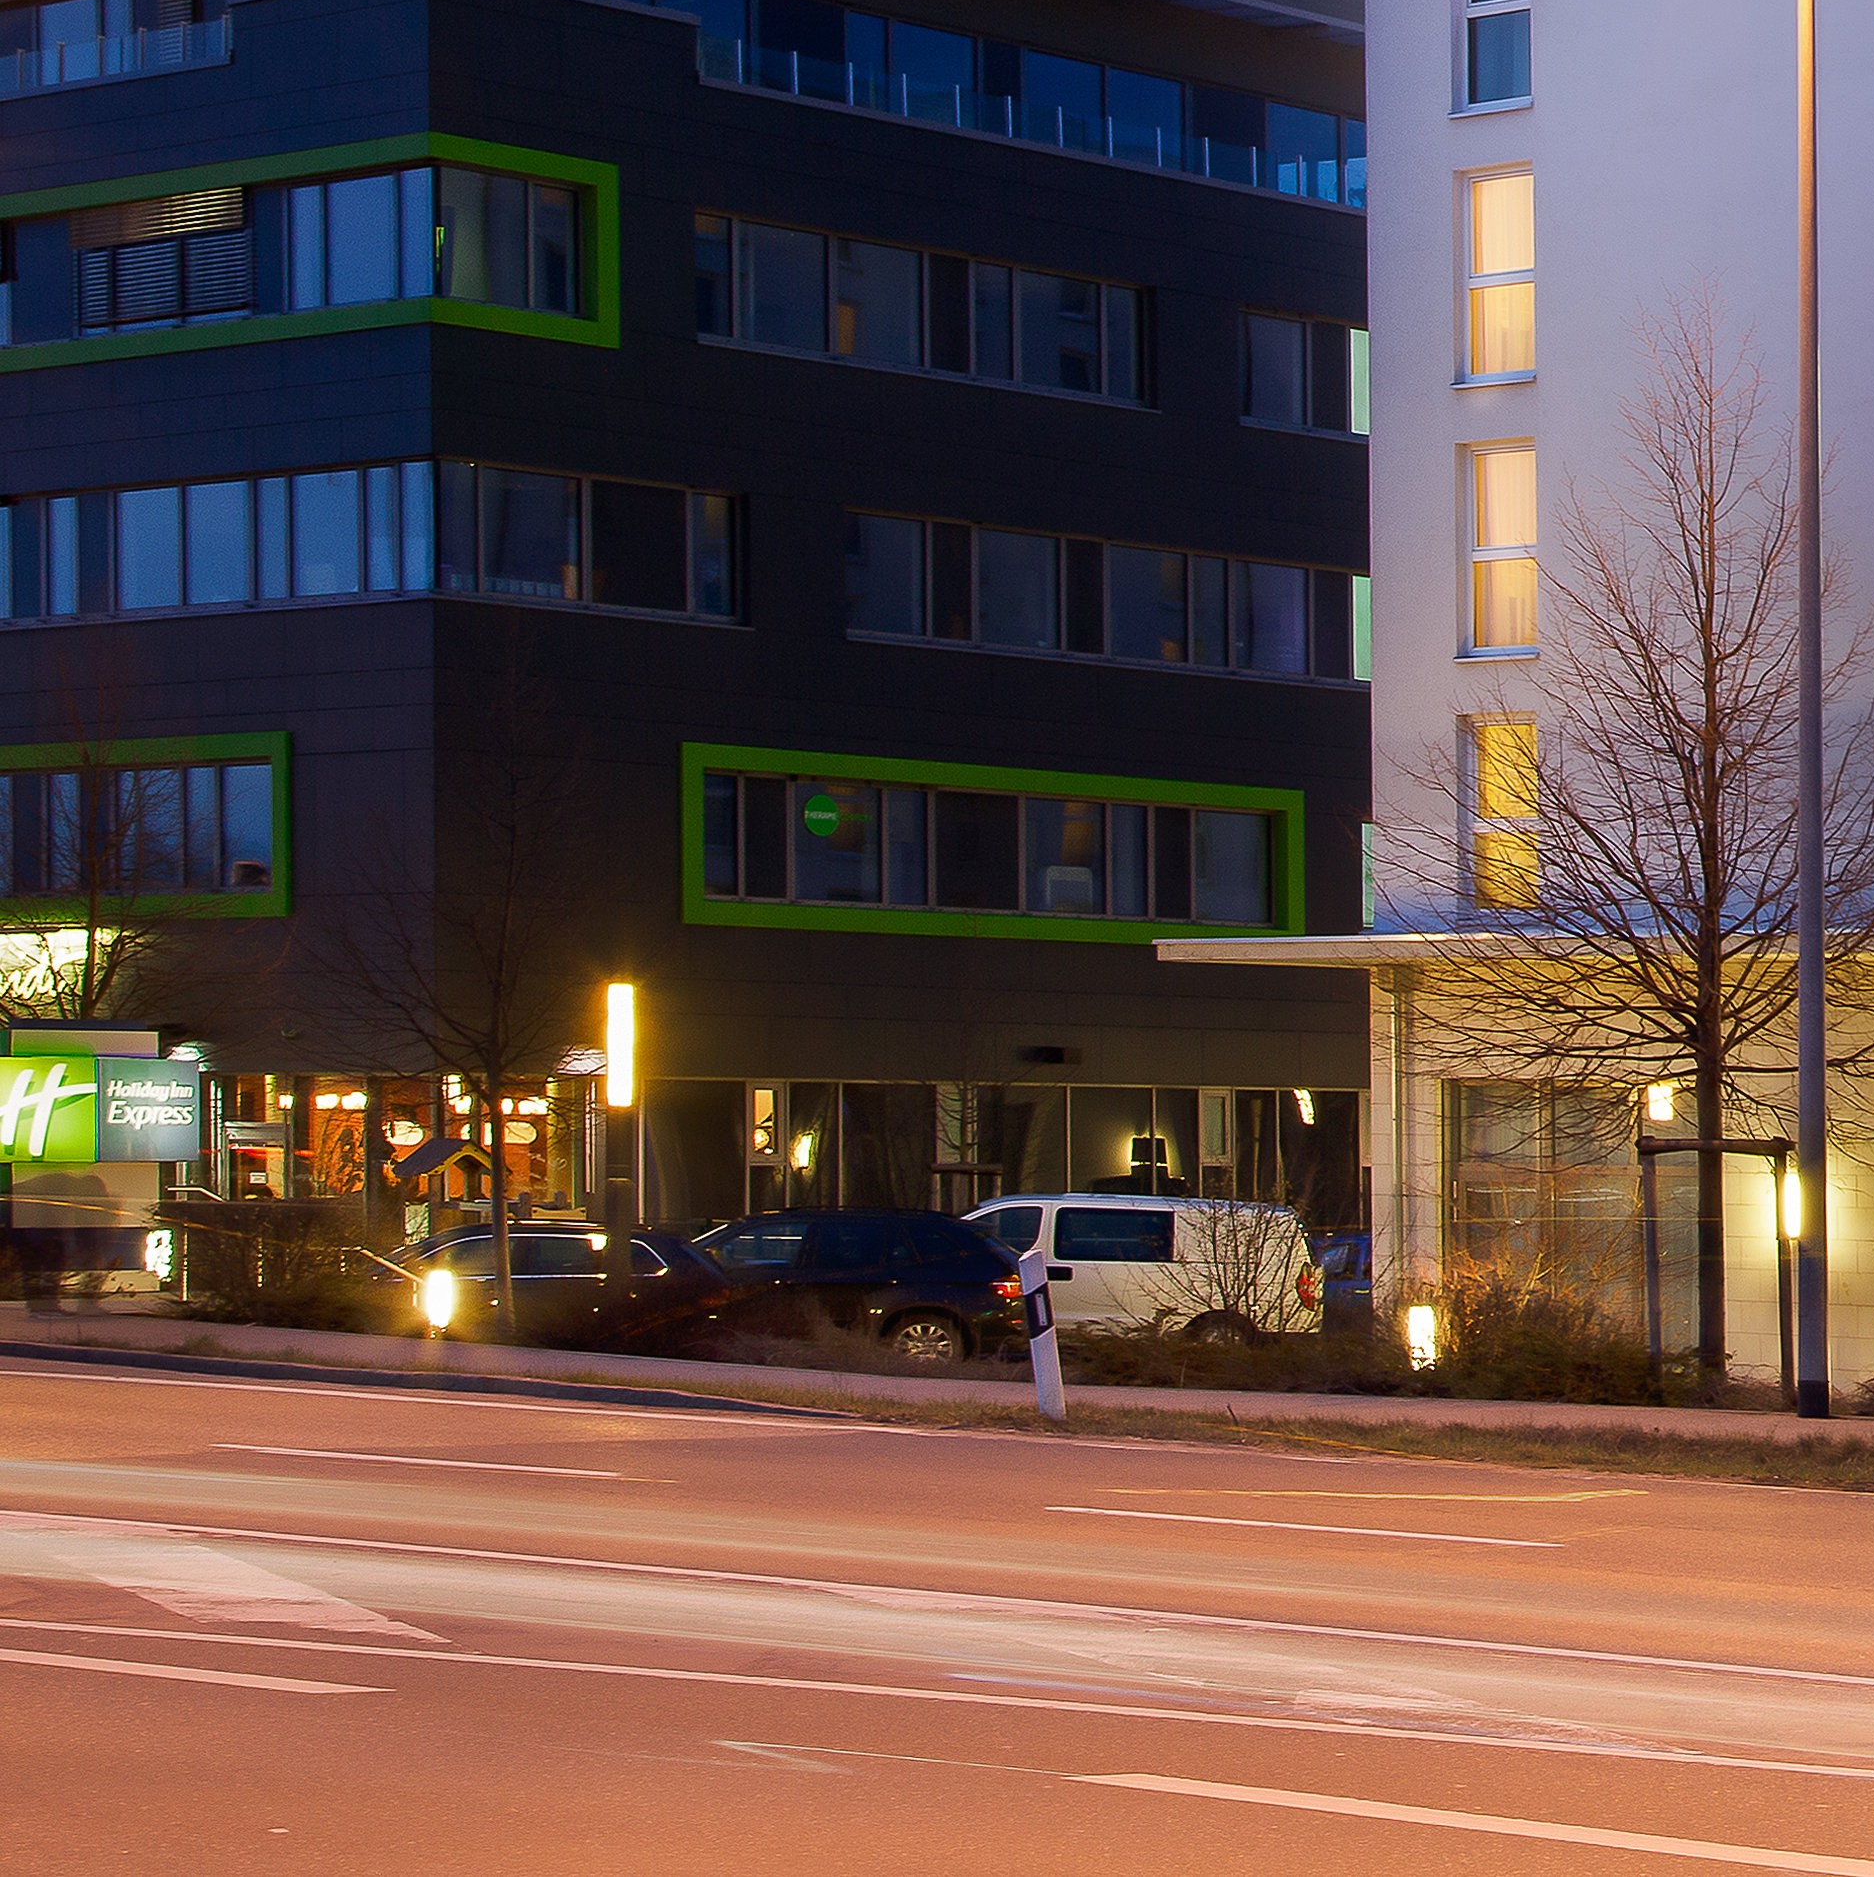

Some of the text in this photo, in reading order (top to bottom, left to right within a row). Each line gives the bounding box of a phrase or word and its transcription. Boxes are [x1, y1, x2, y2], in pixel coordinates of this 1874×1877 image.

[106, 1079, 193, 1101] Holiday Inn
[107, 1100, 195, 1130] Express
